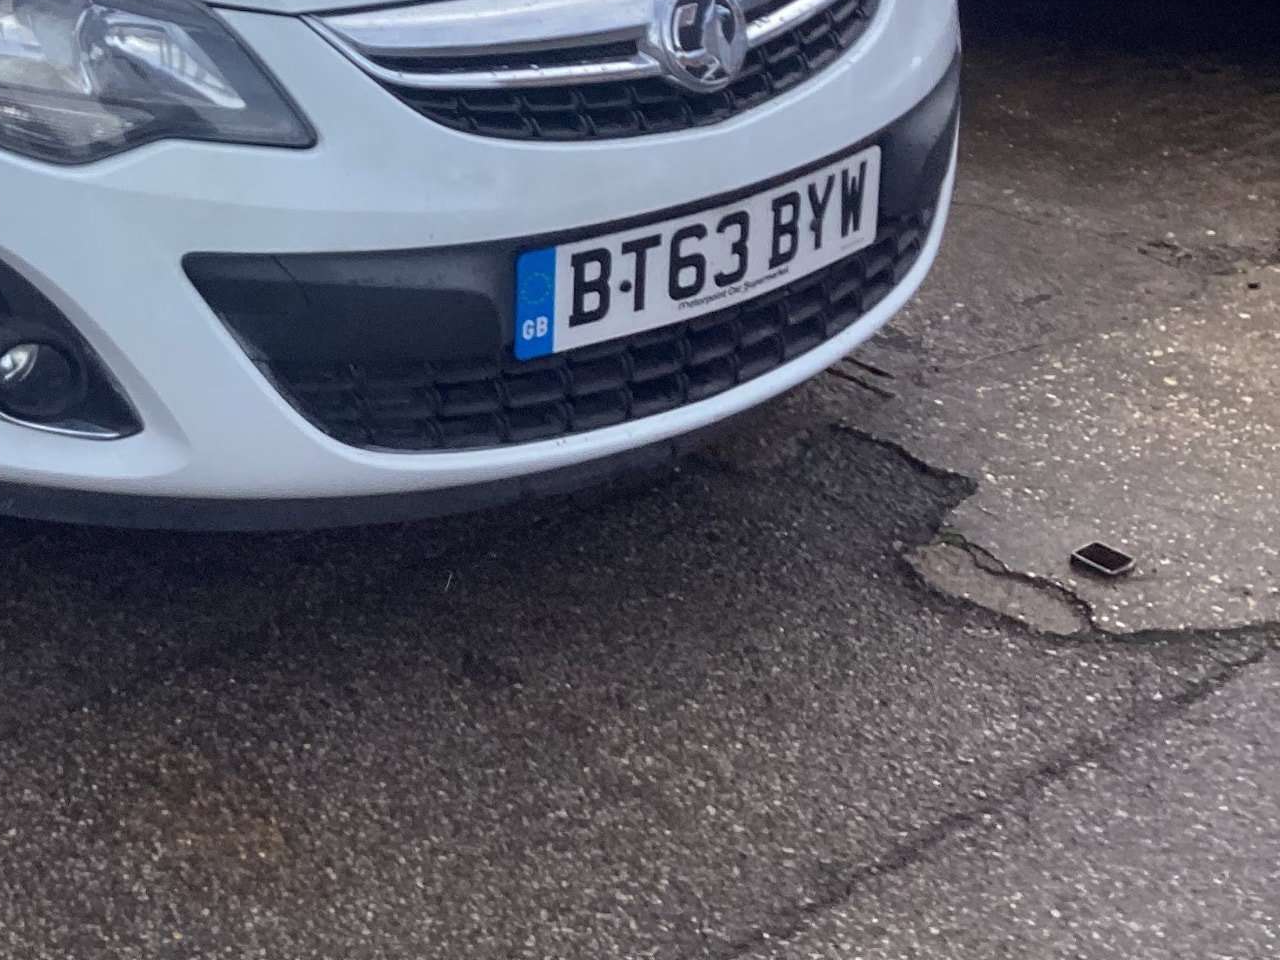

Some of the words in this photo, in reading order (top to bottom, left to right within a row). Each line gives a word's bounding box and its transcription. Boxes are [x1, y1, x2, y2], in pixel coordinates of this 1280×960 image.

[569, 209, 750, 327] BT63
[768, 160, 868, 271] BYW
[522, 315, 549, 341] GB
